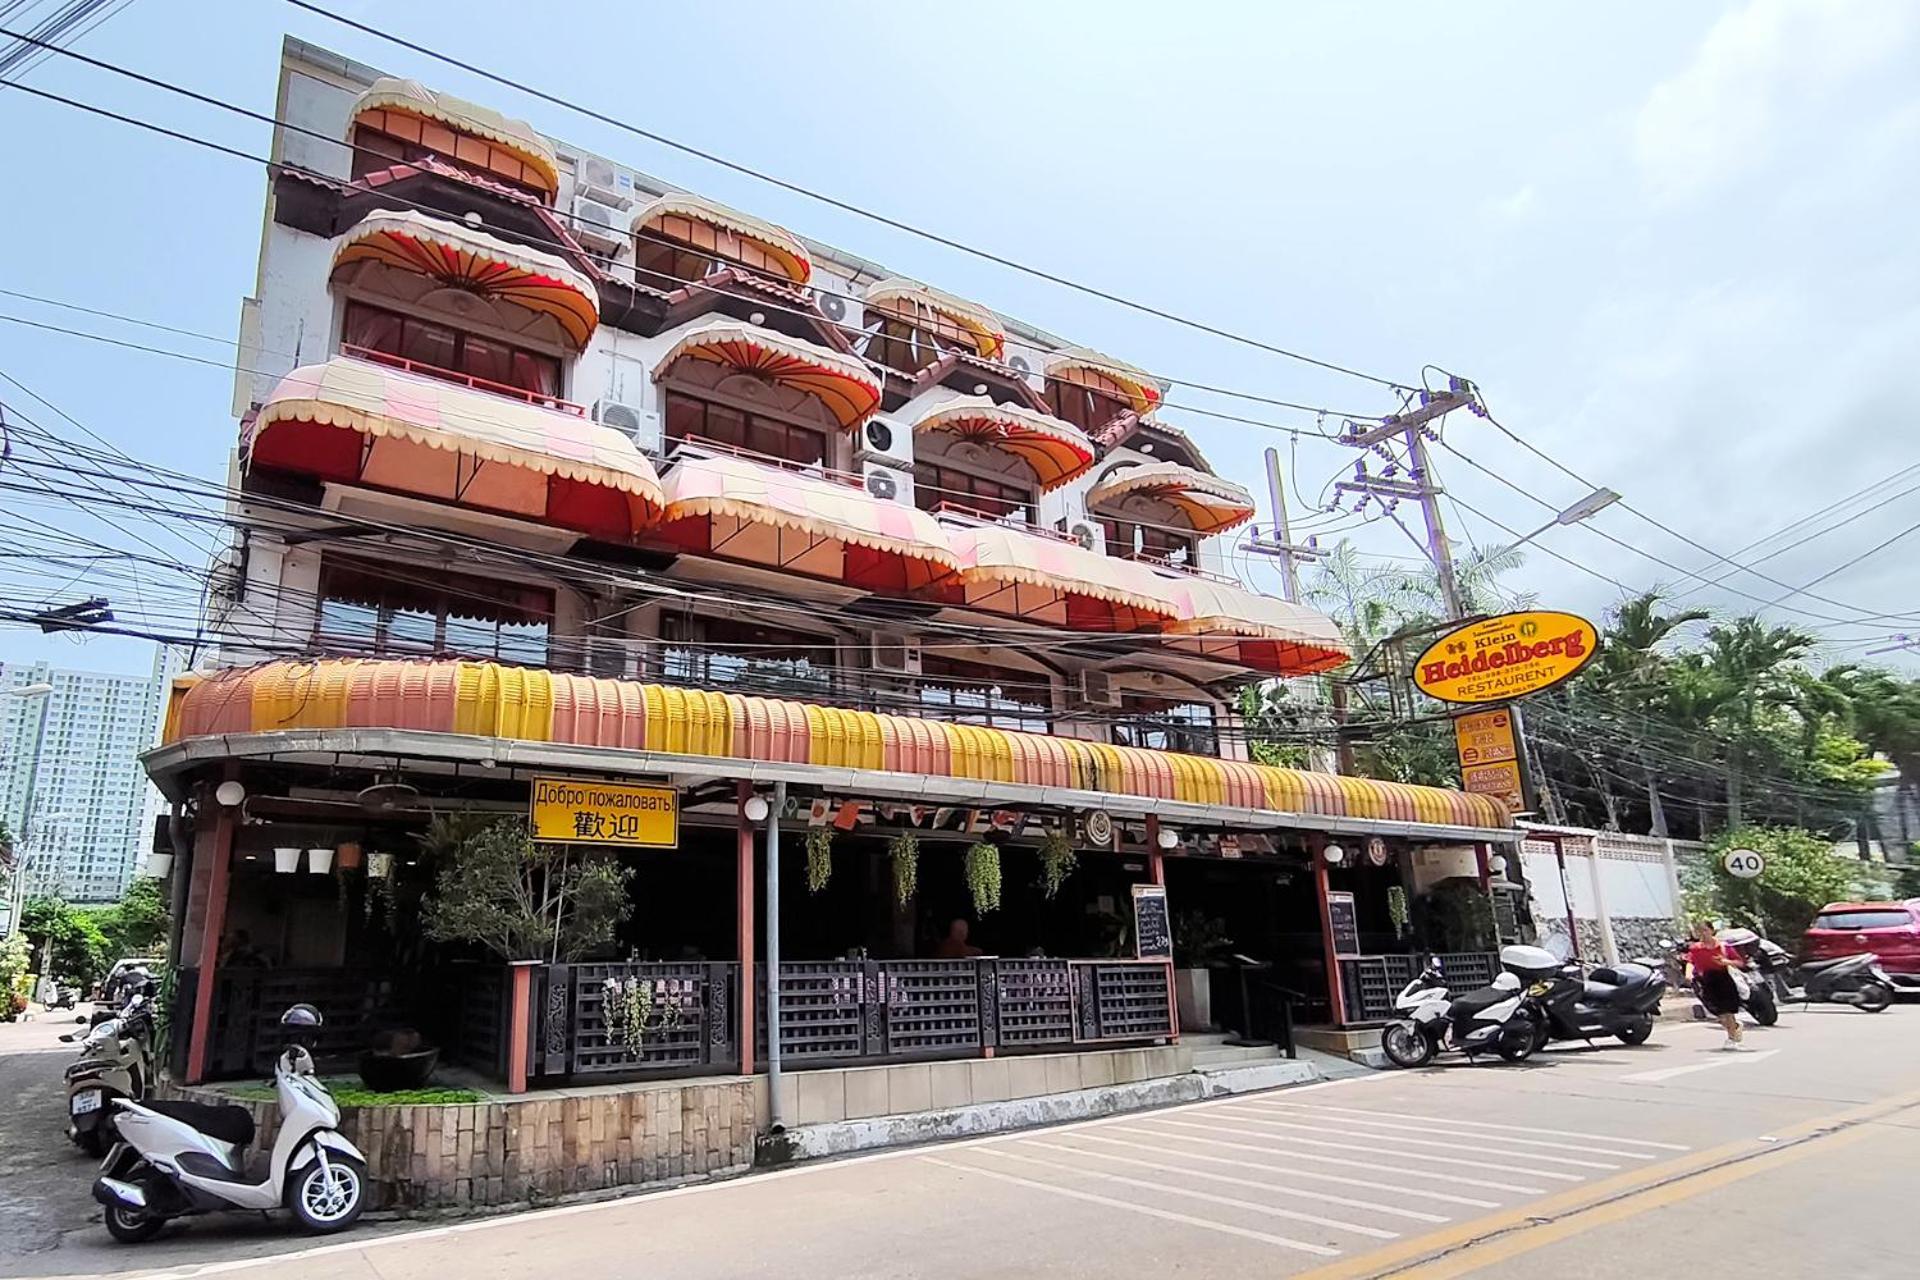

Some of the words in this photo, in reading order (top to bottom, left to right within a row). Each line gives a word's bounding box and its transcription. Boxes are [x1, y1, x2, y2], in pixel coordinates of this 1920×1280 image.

[1475, 633, 1516, 649] Klein
[1423, 630, 1585, 685] Heidelberg
[1457, 666, 1556, 696] RESTAURENT
[536, 783, 585, 809] Добро
[589, 791, 675, 812] пожаловать!
[573, 811, 640, 840] 歡迎
[1730, 856, 1759, 871] 40
